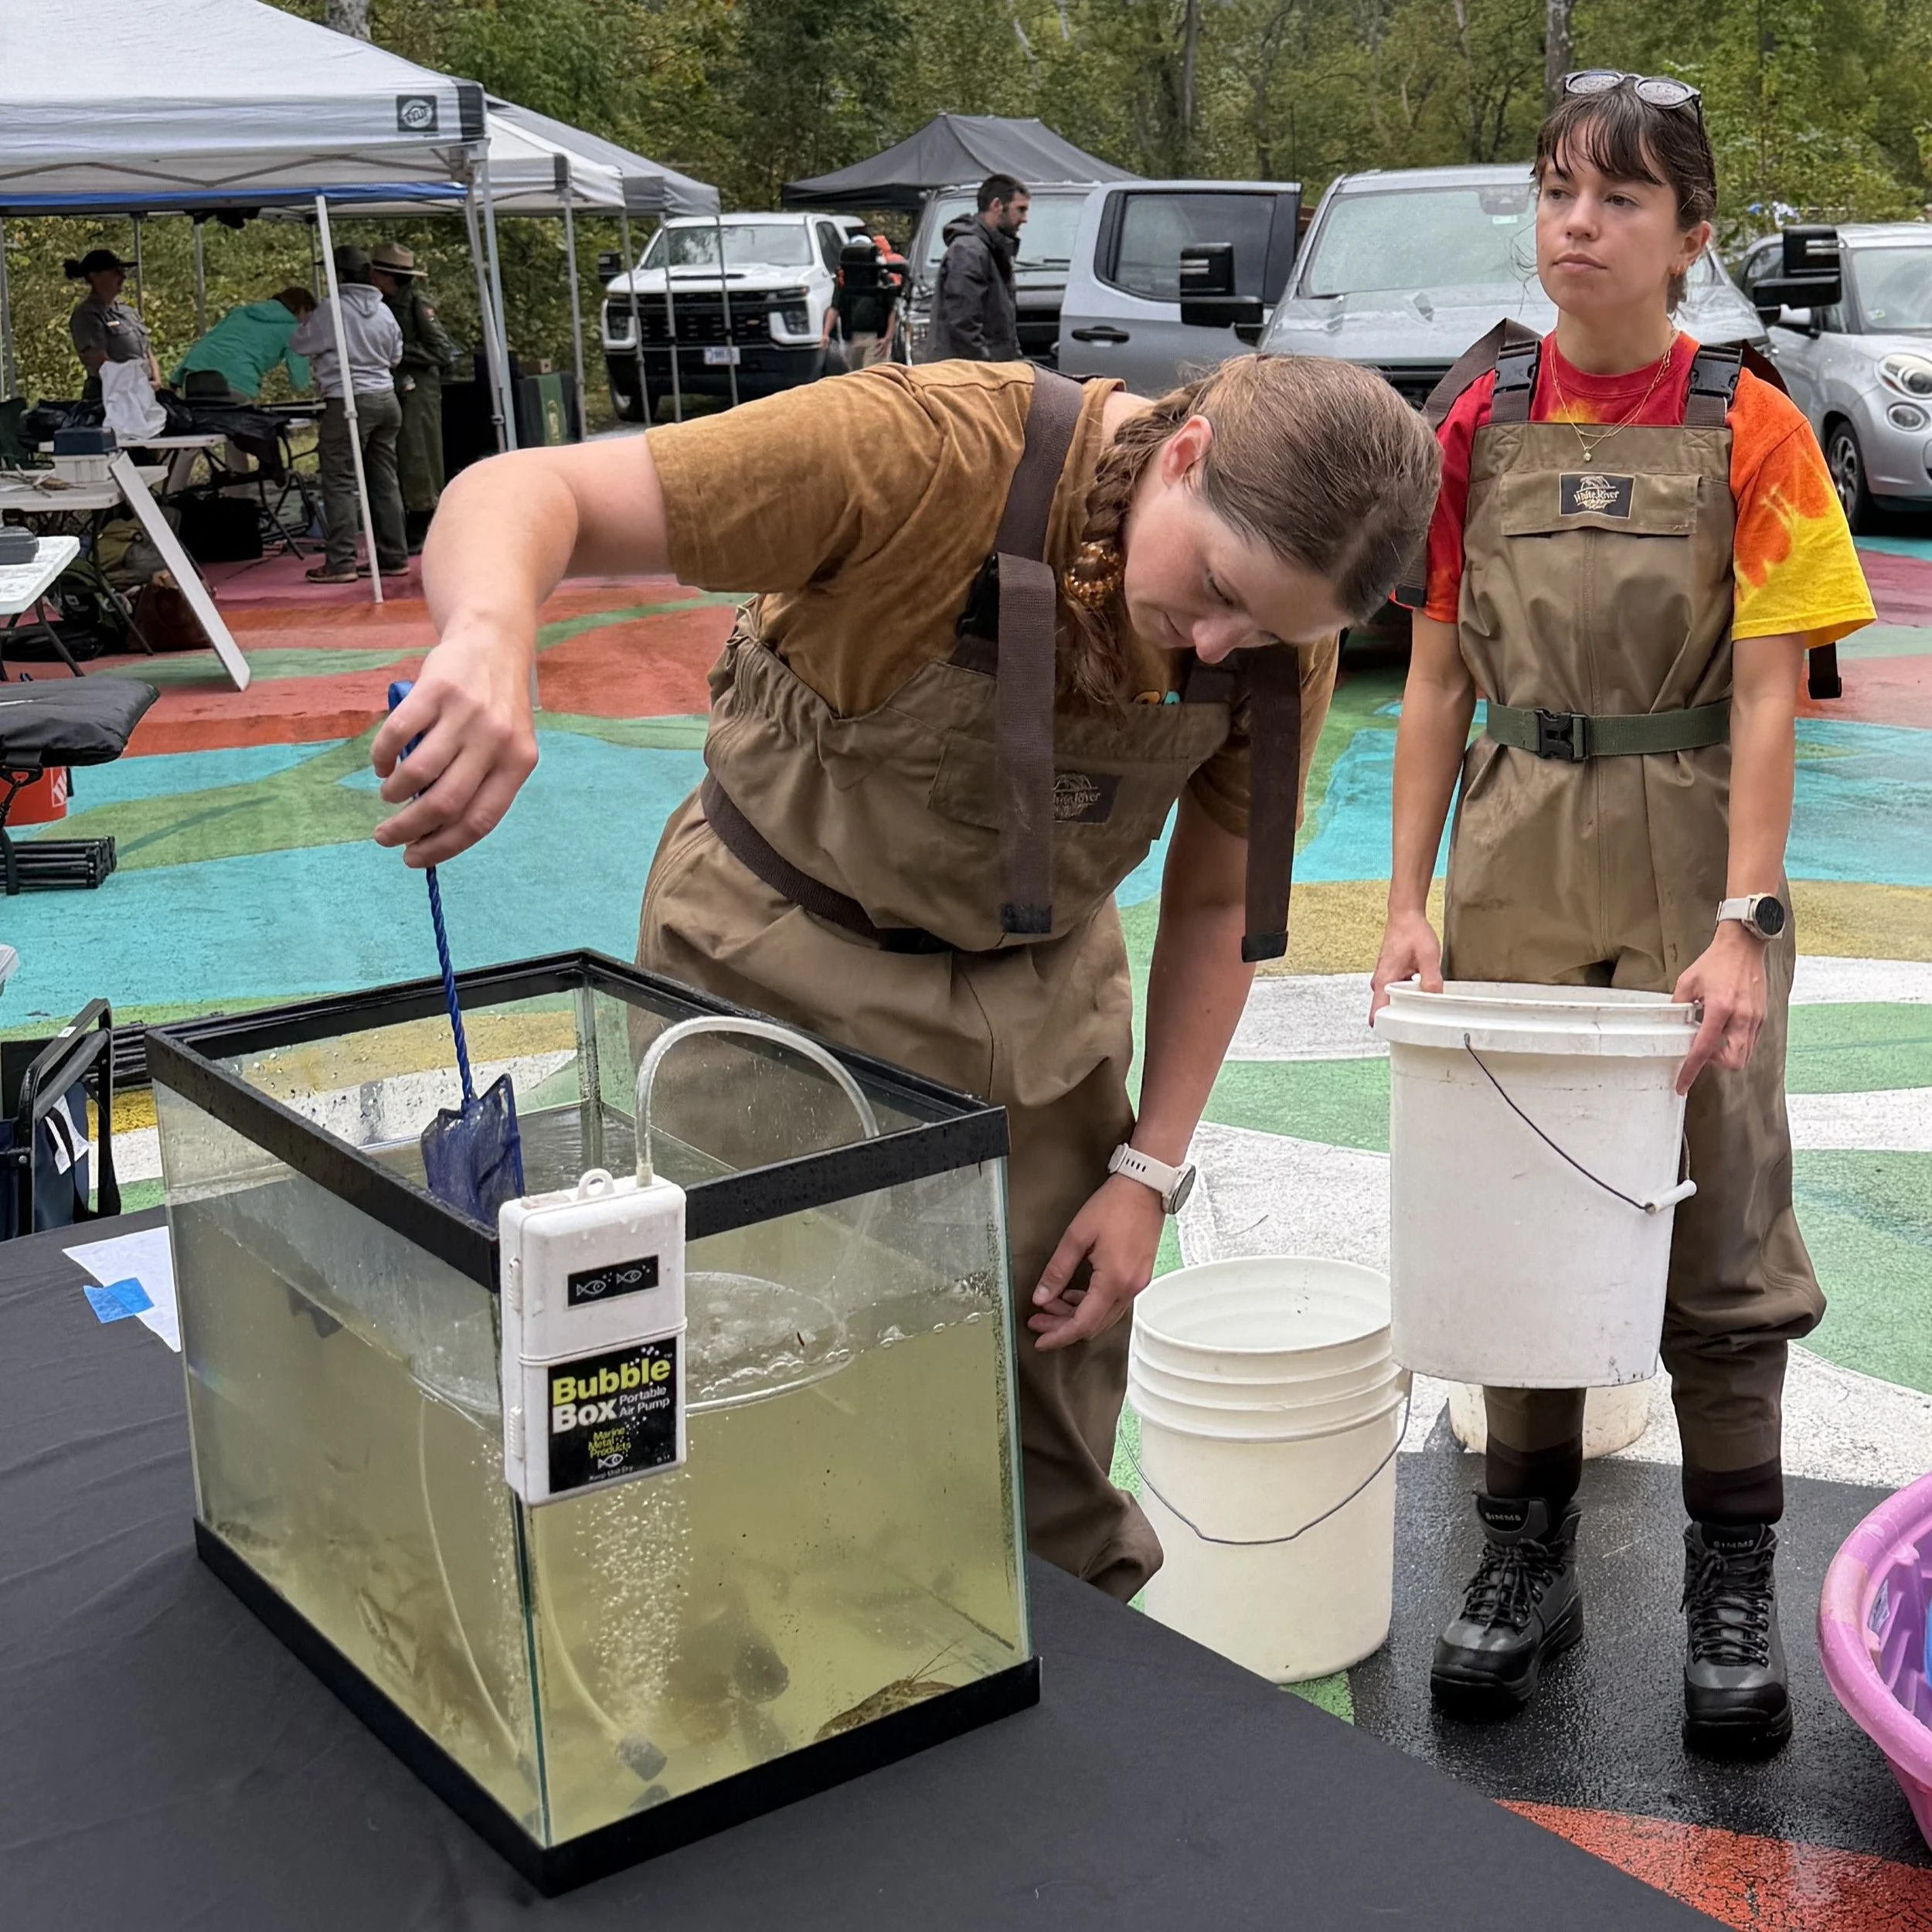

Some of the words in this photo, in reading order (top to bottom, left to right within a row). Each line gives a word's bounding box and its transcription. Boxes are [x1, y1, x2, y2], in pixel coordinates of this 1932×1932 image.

[1573, 490, 1597, 503] White
[1597, 488, 1620, 499] River
[553, 1358, 672, 1406] Bubble
[619, 1386, 667, 1406] Portable
[553, 1397, 617, 1434] Box
[619, 1406, 634, 1418] Air
[638, 1397, 671, 1413] Pump
[593, 1427, 626, 1440] Marine
[588, 1435, 615, 1451] Metal
[590, 1441, 632, 1459] Products
[1485, 1512, 1522, 1522] SIMMS
[1713, 1539, 1754, 1549] SIMMS
